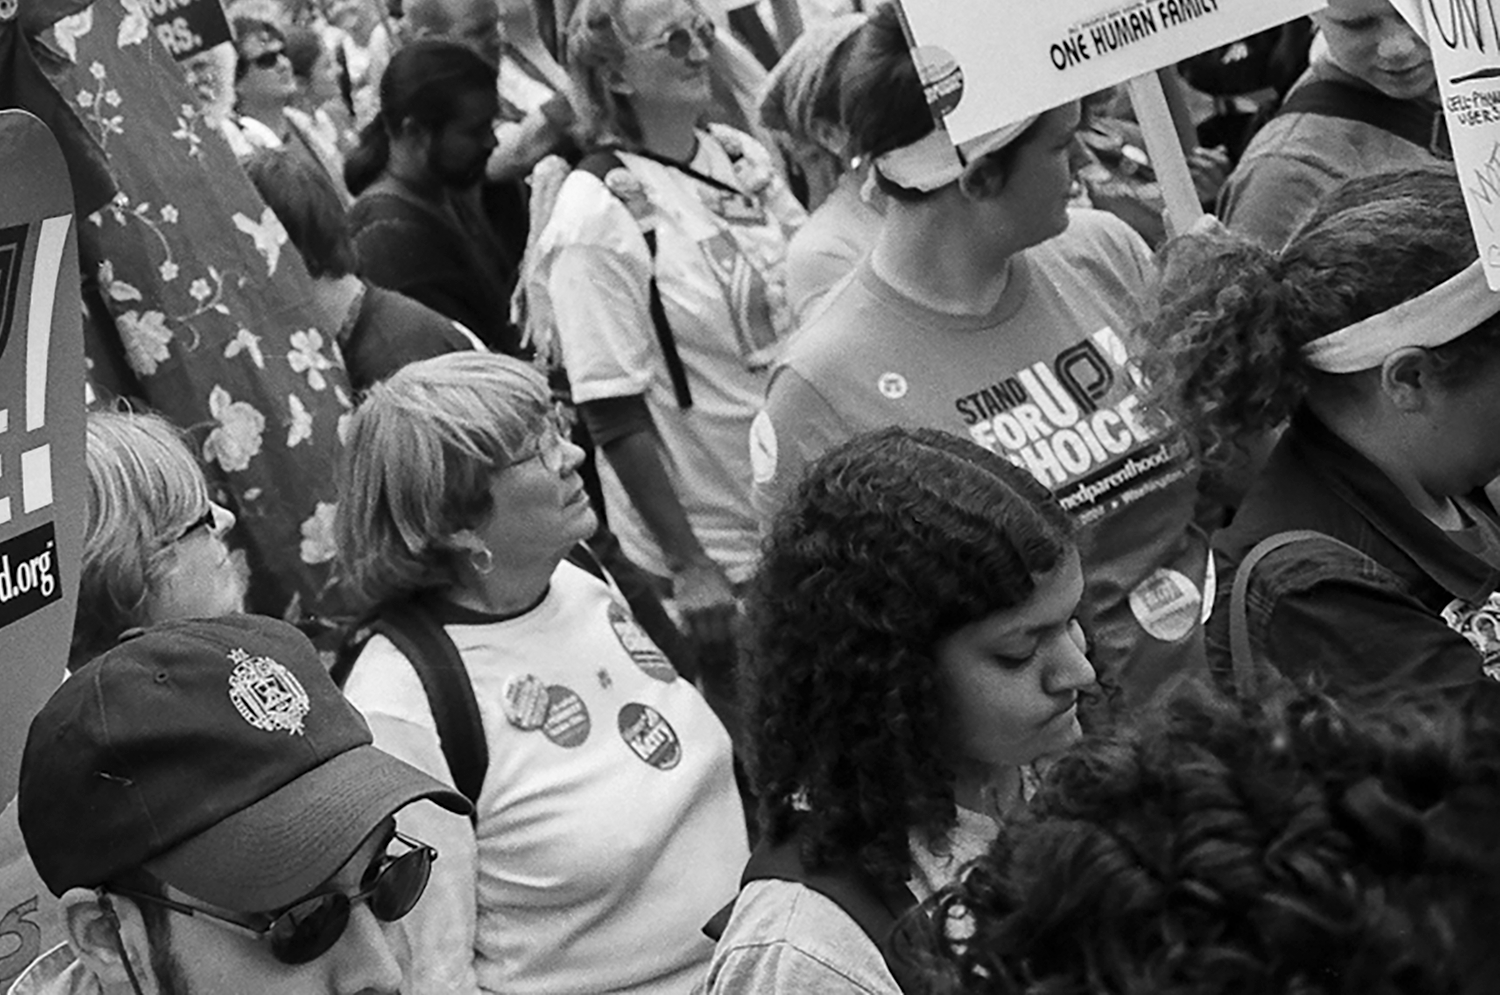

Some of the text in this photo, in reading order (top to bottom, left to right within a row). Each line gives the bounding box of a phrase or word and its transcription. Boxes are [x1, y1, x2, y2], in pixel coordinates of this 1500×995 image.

[1049, 34, 1091, 71] ONE
[1089, 7, 1158, 56] HUMAN
[955, 377, 1027, 425] STAND
[969, 402, 1053, 454] FOR
